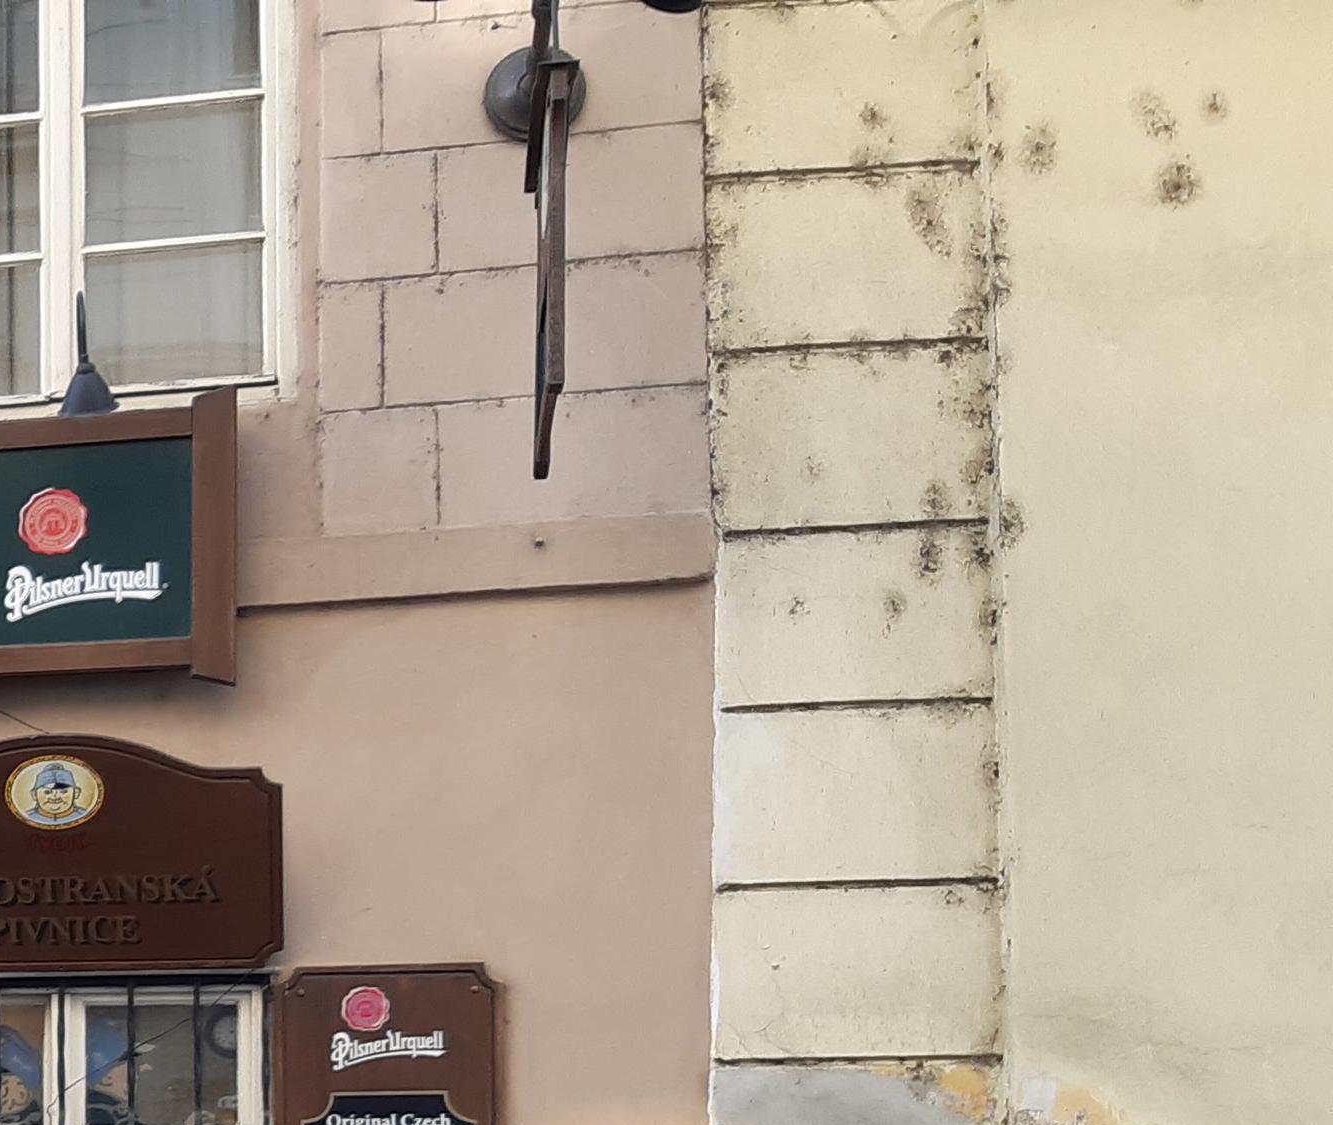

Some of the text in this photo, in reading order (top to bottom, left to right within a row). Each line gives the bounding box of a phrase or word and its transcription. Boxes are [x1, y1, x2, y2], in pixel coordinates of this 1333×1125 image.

[4, 561, 161, 622] Pilsner Urquell
[330, 1030, 444, 1071] Pilsner Urquell
